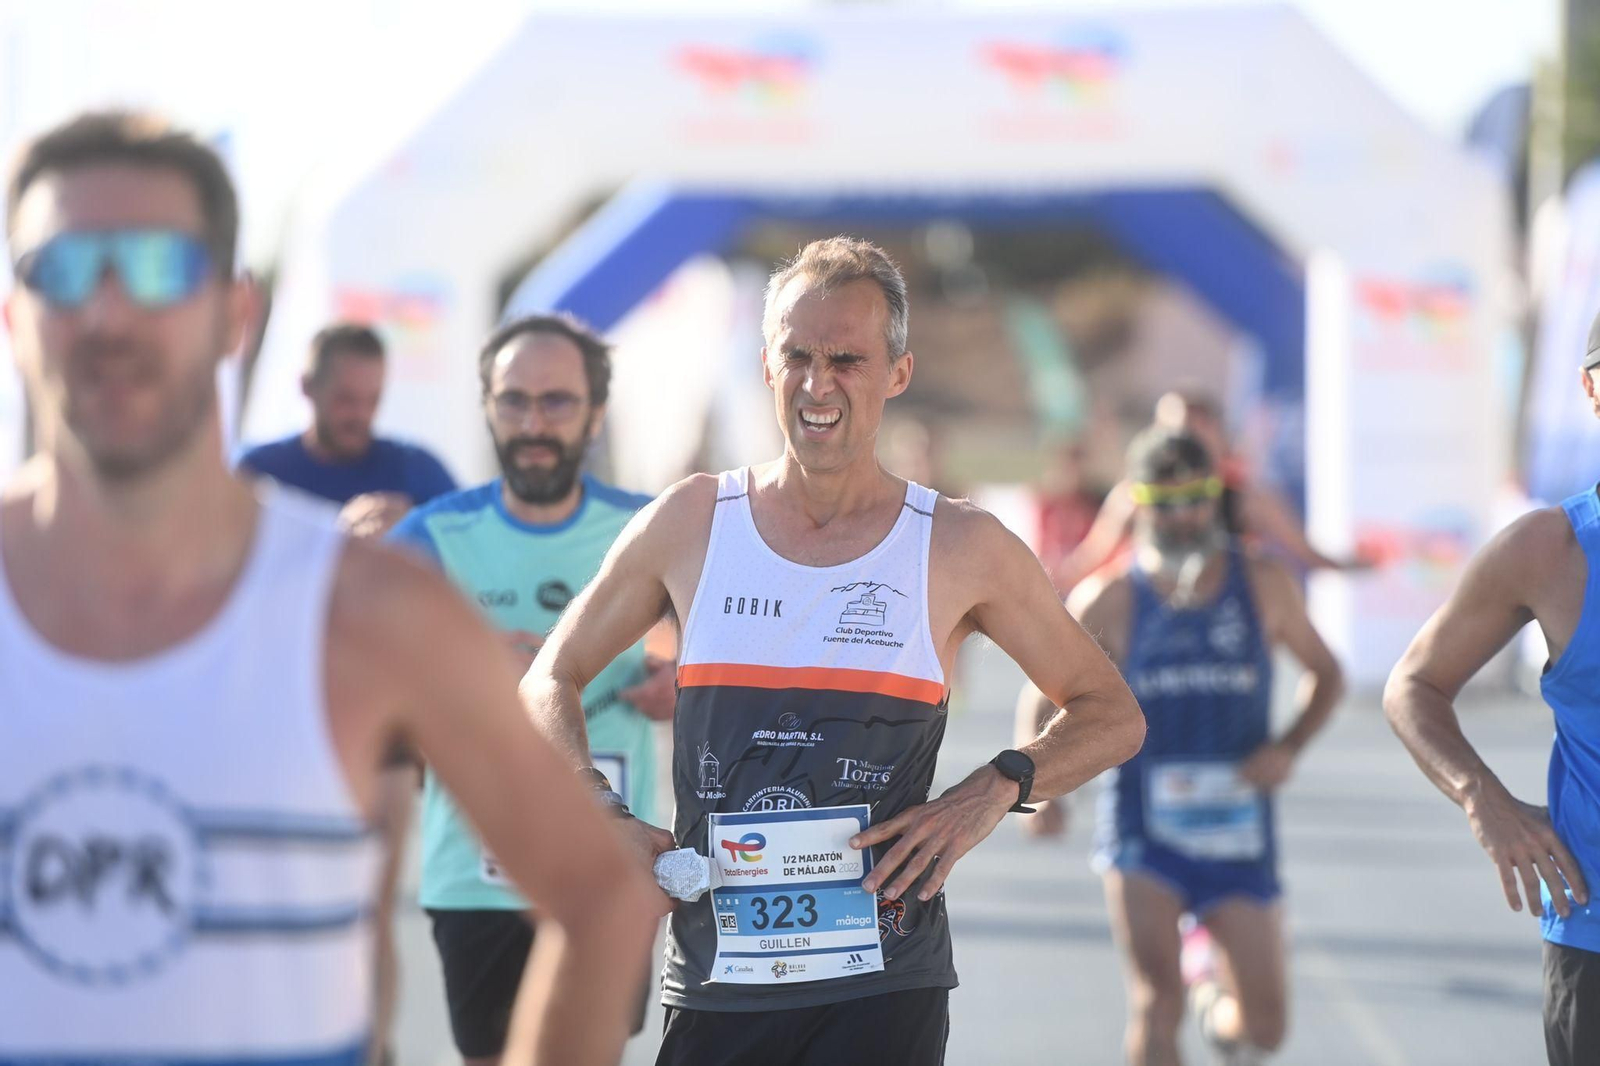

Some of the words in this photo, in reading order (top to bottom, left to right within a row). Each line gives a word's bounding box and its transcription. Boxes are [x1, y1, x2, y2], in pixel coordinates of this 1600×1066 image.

[724, 596, 782, 617] GOBIK
[835, 626, 853, 635] Club
[854, 628, 894, 638] Deportivo
[822, 635, 850, 644] Fuente
[850, 636, 863, 644] del
[864, 638, 904, 648] Acebuche
[810, 732, 824, 741] S.L.
[742, 785, 785, 812] CARPINTERIA
[782, 855, 797, 864] 1/2
[798, 851, 843, 863] MARATÓN
[723, 867, 769, 877] TotalEnergies
[783, 867, 796, 876] DE
[797, 864, 836, 875] MÁLAGA
[838, 862, 859, 873] 2022
[750, 894, 819, 931] 323
[759, 937, 811, 950] GUILLEN
